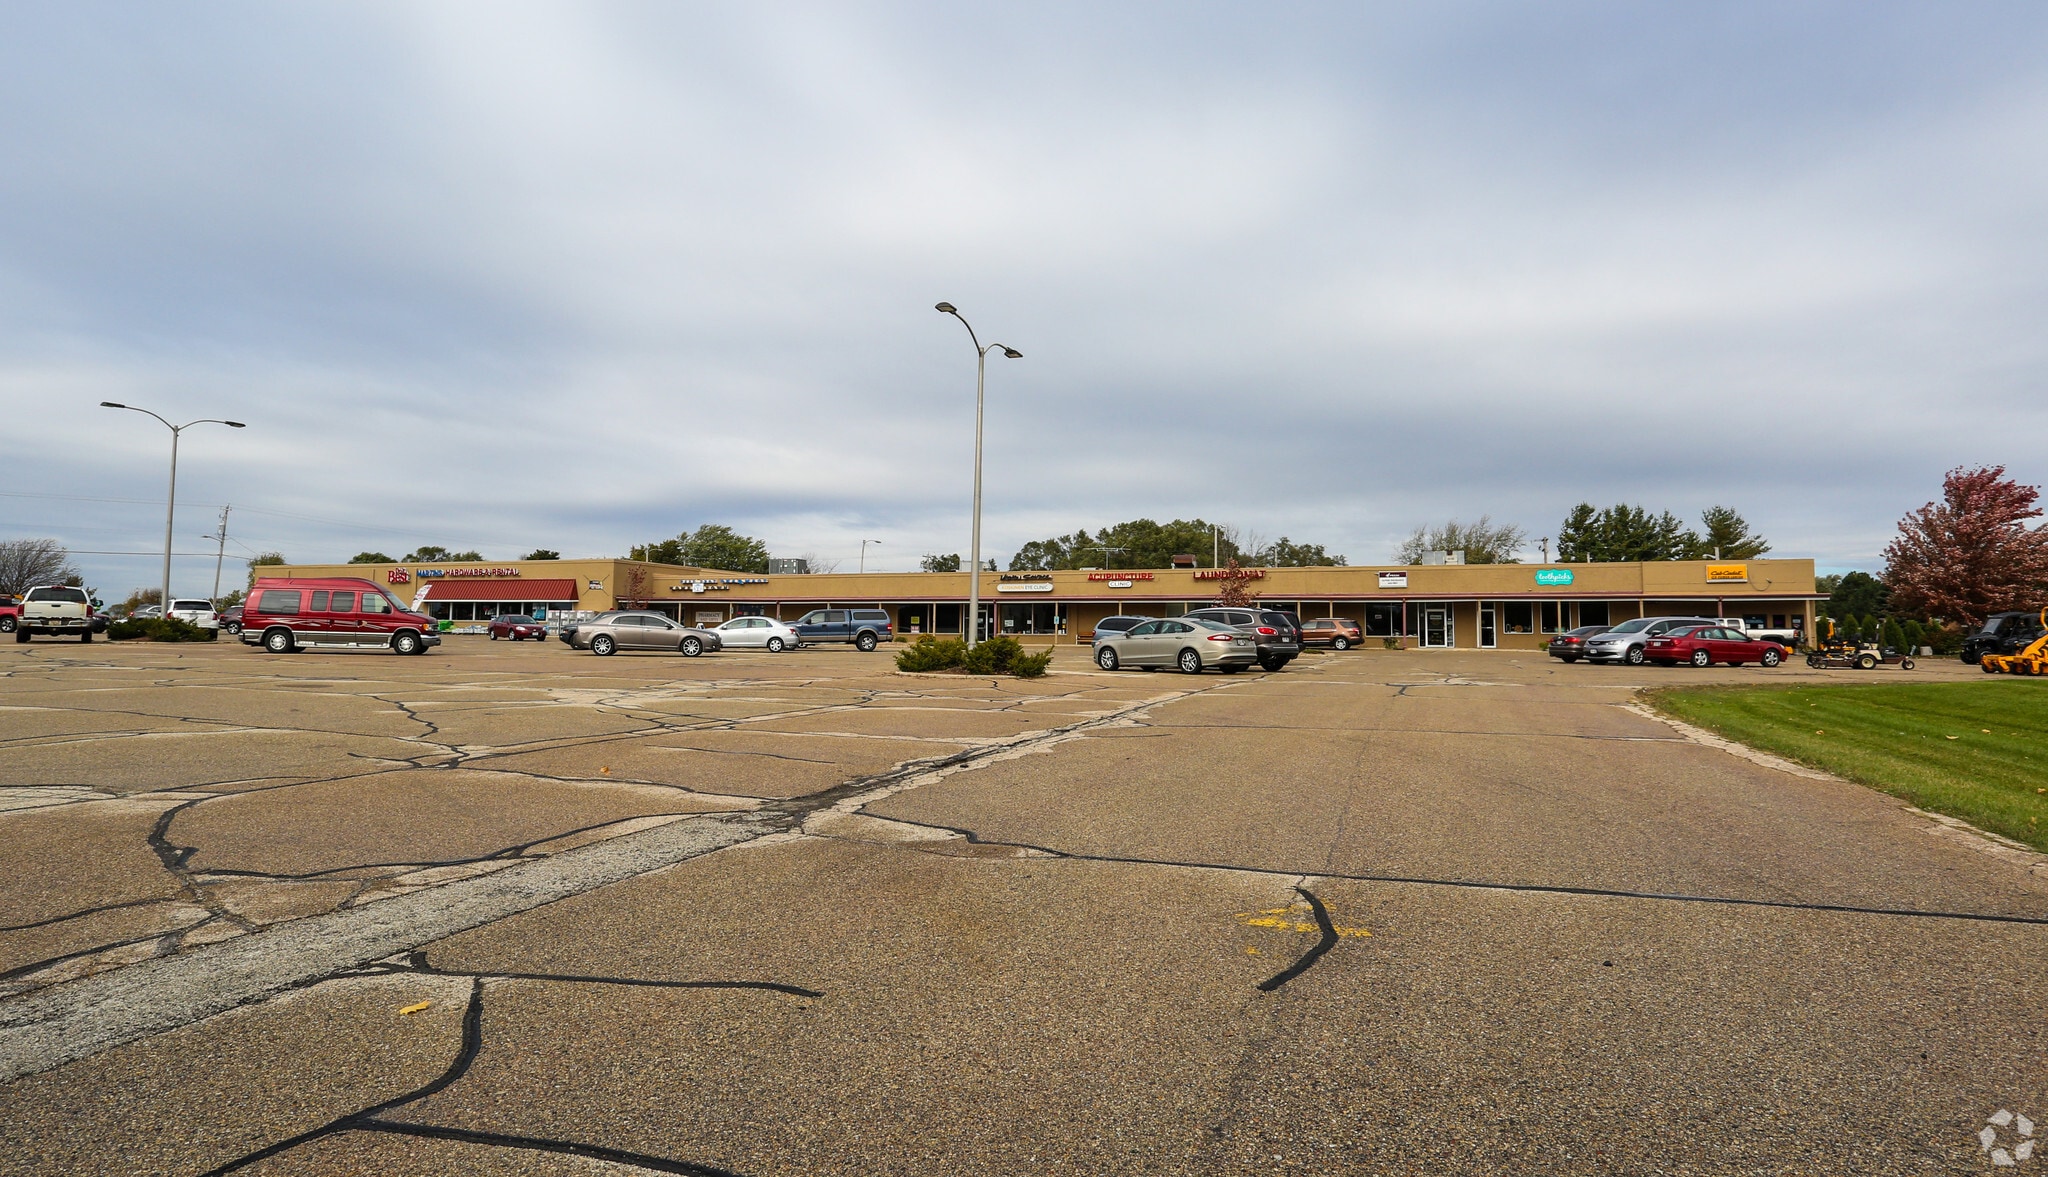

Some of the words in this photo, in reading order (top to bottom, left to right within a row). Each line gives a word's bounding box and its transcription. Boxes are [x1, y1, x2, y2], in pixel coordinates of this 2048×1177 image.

[492, 568, 521, 576] RENTAL
[1088, 572, 1154, 581] ACUPUNCTURE
[1538, 572, 1571, 583] toothpicks
